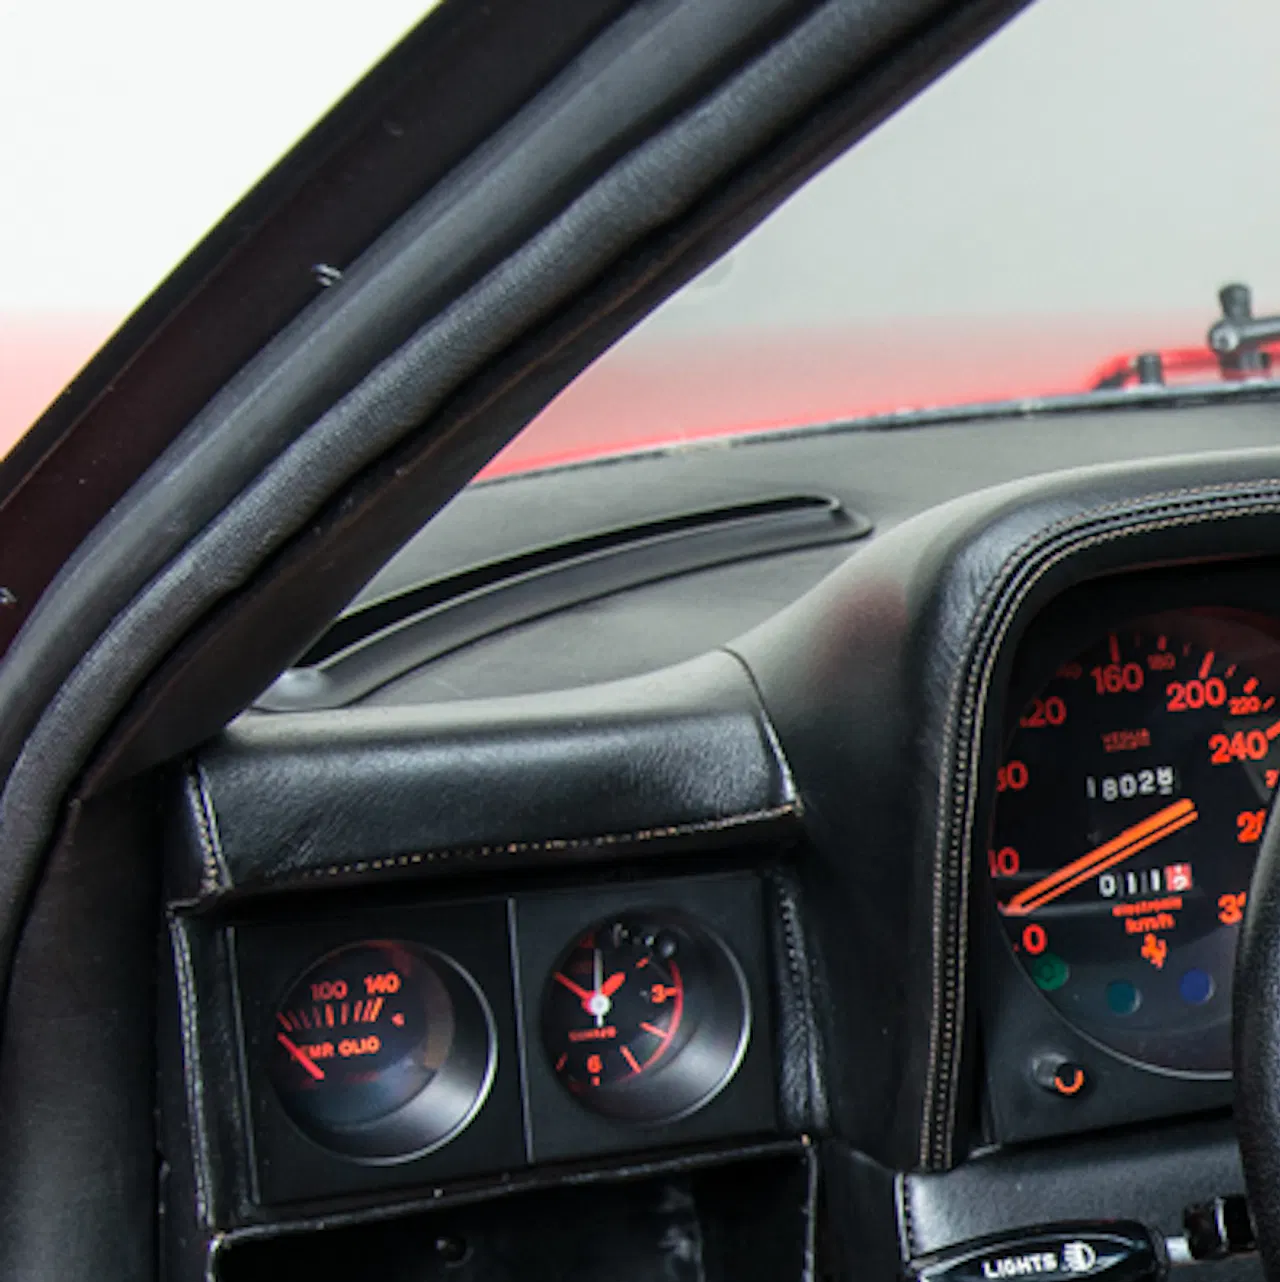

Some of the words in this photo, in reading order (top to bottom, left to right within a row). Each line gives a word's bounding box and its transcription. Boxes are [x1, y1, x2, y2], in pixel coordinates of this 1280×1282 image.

[1090, 662, 1145, 696] 160
[1166, 676, 1227, 713] 200
[1019, 696, 1068, 729] 20
[1208, 728, 1269, 766] 240
[1022, 923, 1049, 955] 0
[309, 978, 349, 1001] 100
[364, 971, 403, 996] 140
[651, 983, 666, 1005] 3
[338, 1035, 382, 1058] OLIO
[981, 1251, 1058, 1280] LIGHTS
